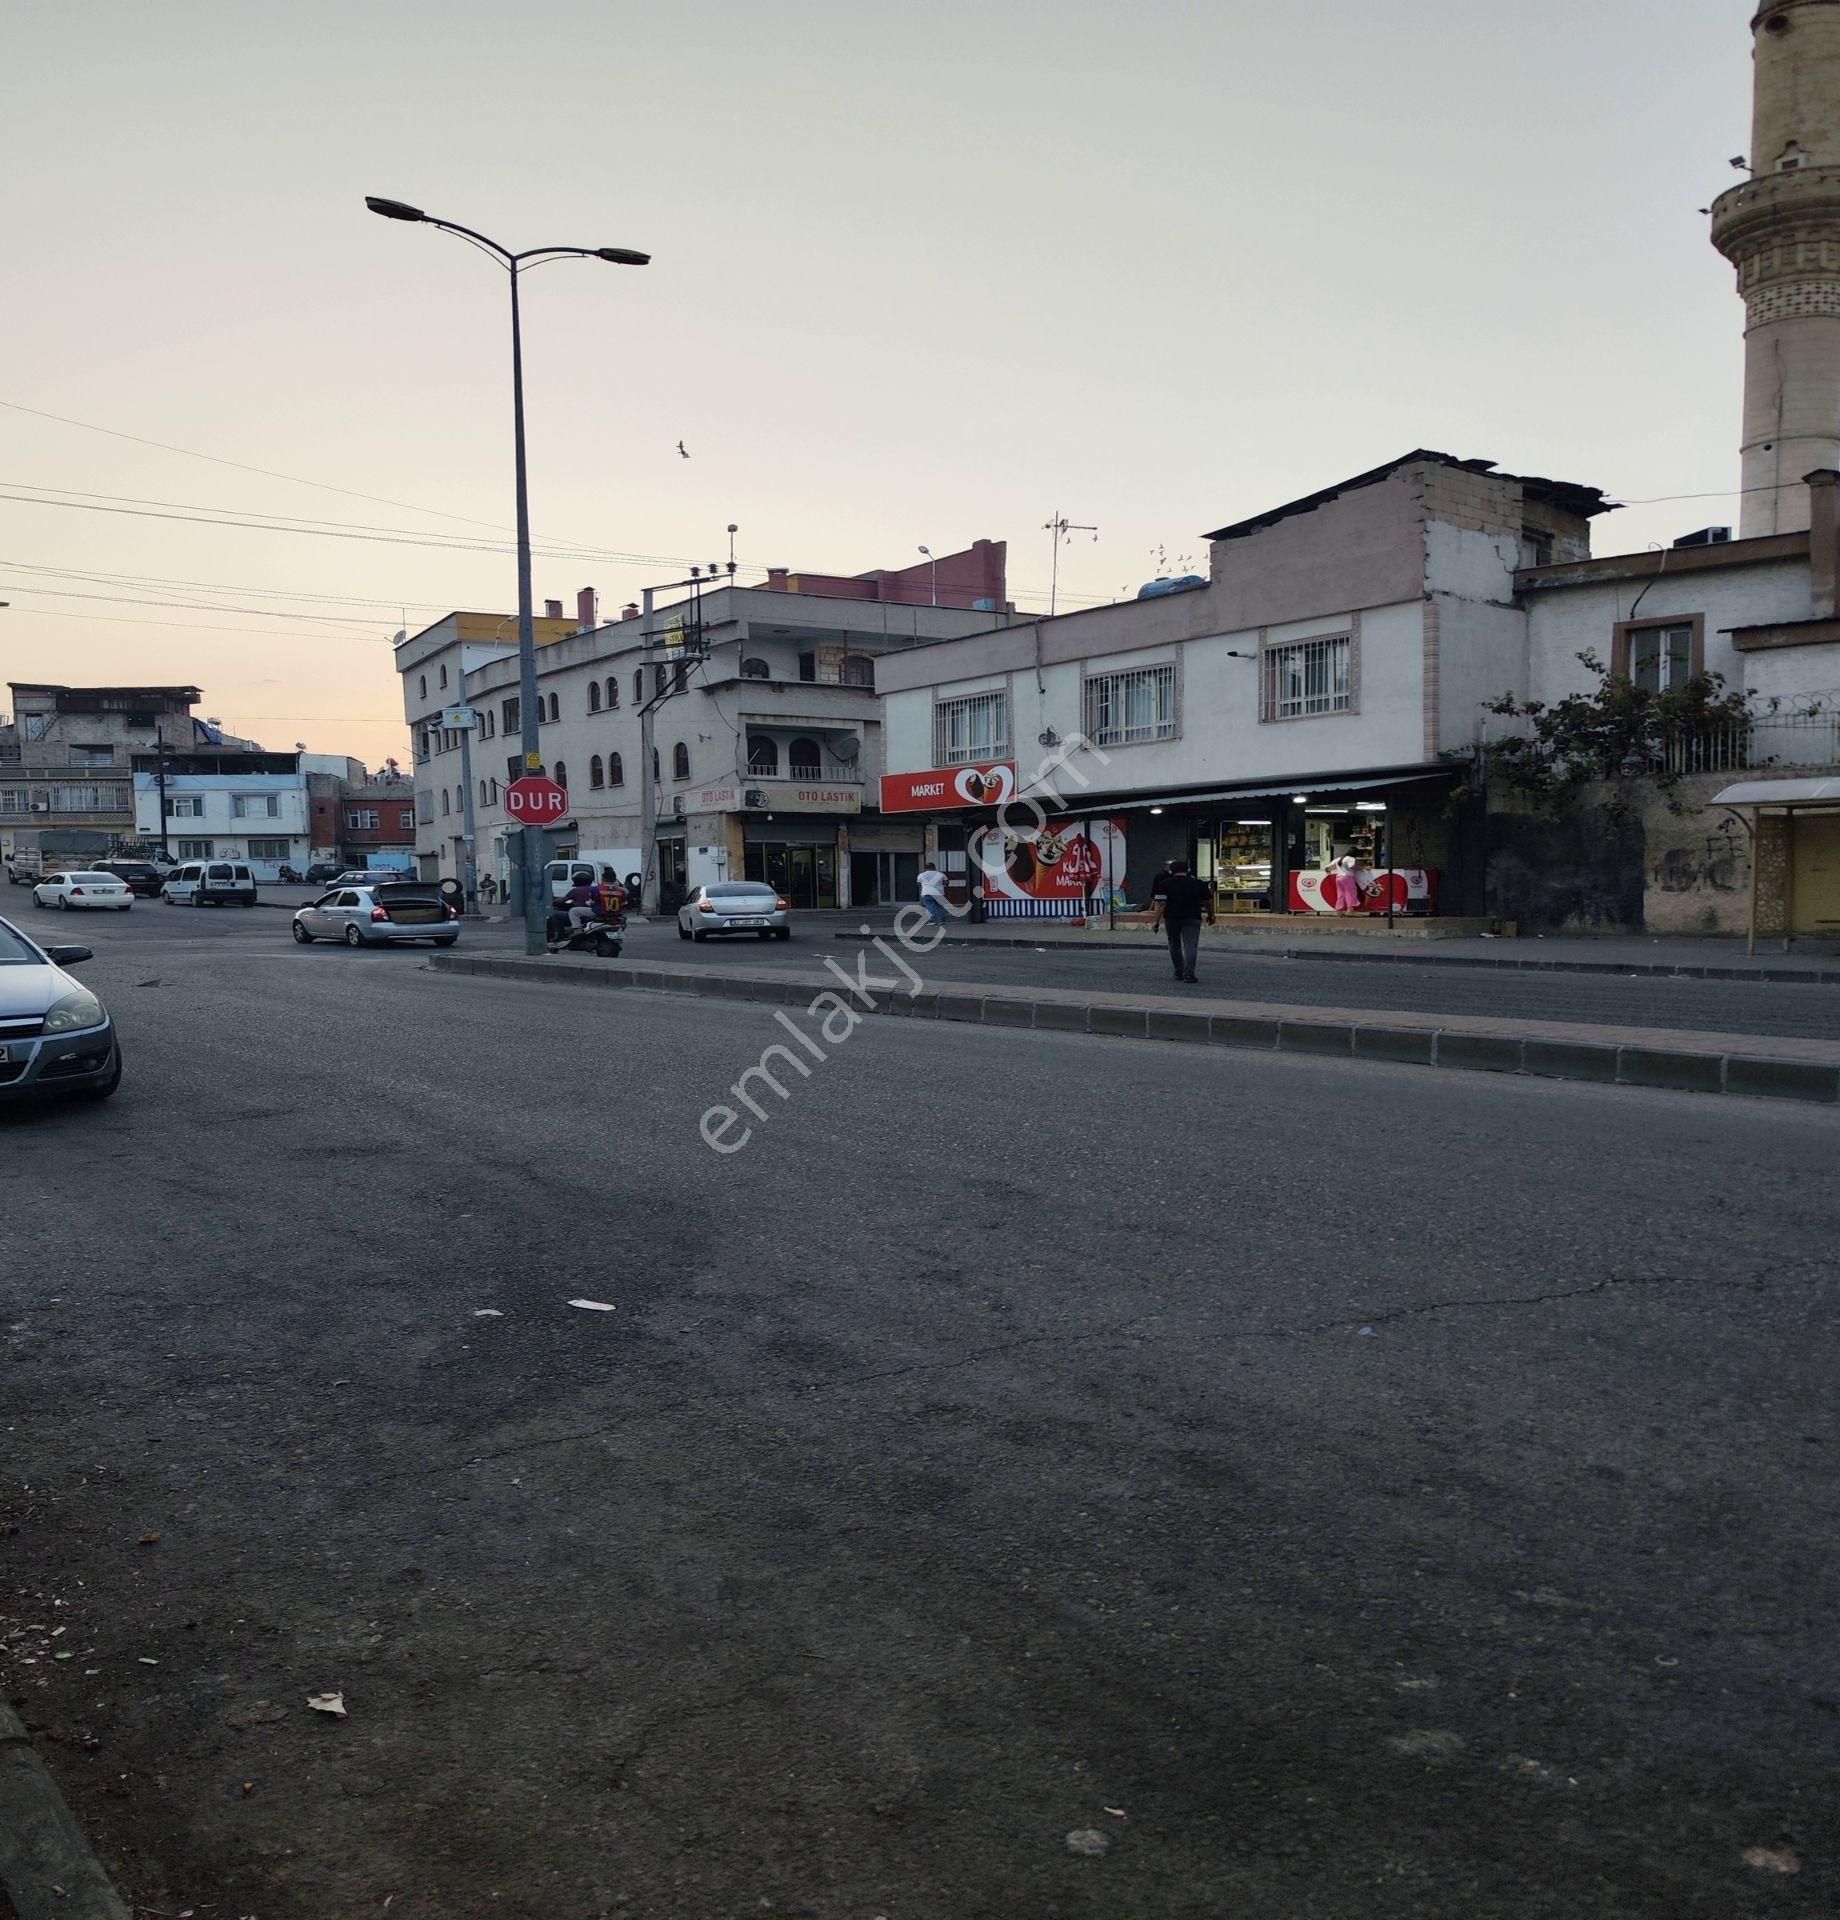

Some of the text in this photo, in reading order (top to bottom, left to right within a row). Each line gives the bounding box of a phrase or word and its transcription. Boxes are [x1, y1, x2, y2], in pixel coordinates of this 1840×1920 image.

[701, 790, 714, 803] OTO
[798, 791, 818, 801] OTO
[911, 782, 945, 798] MARKET
[510, 792, 562, 810] DUR
